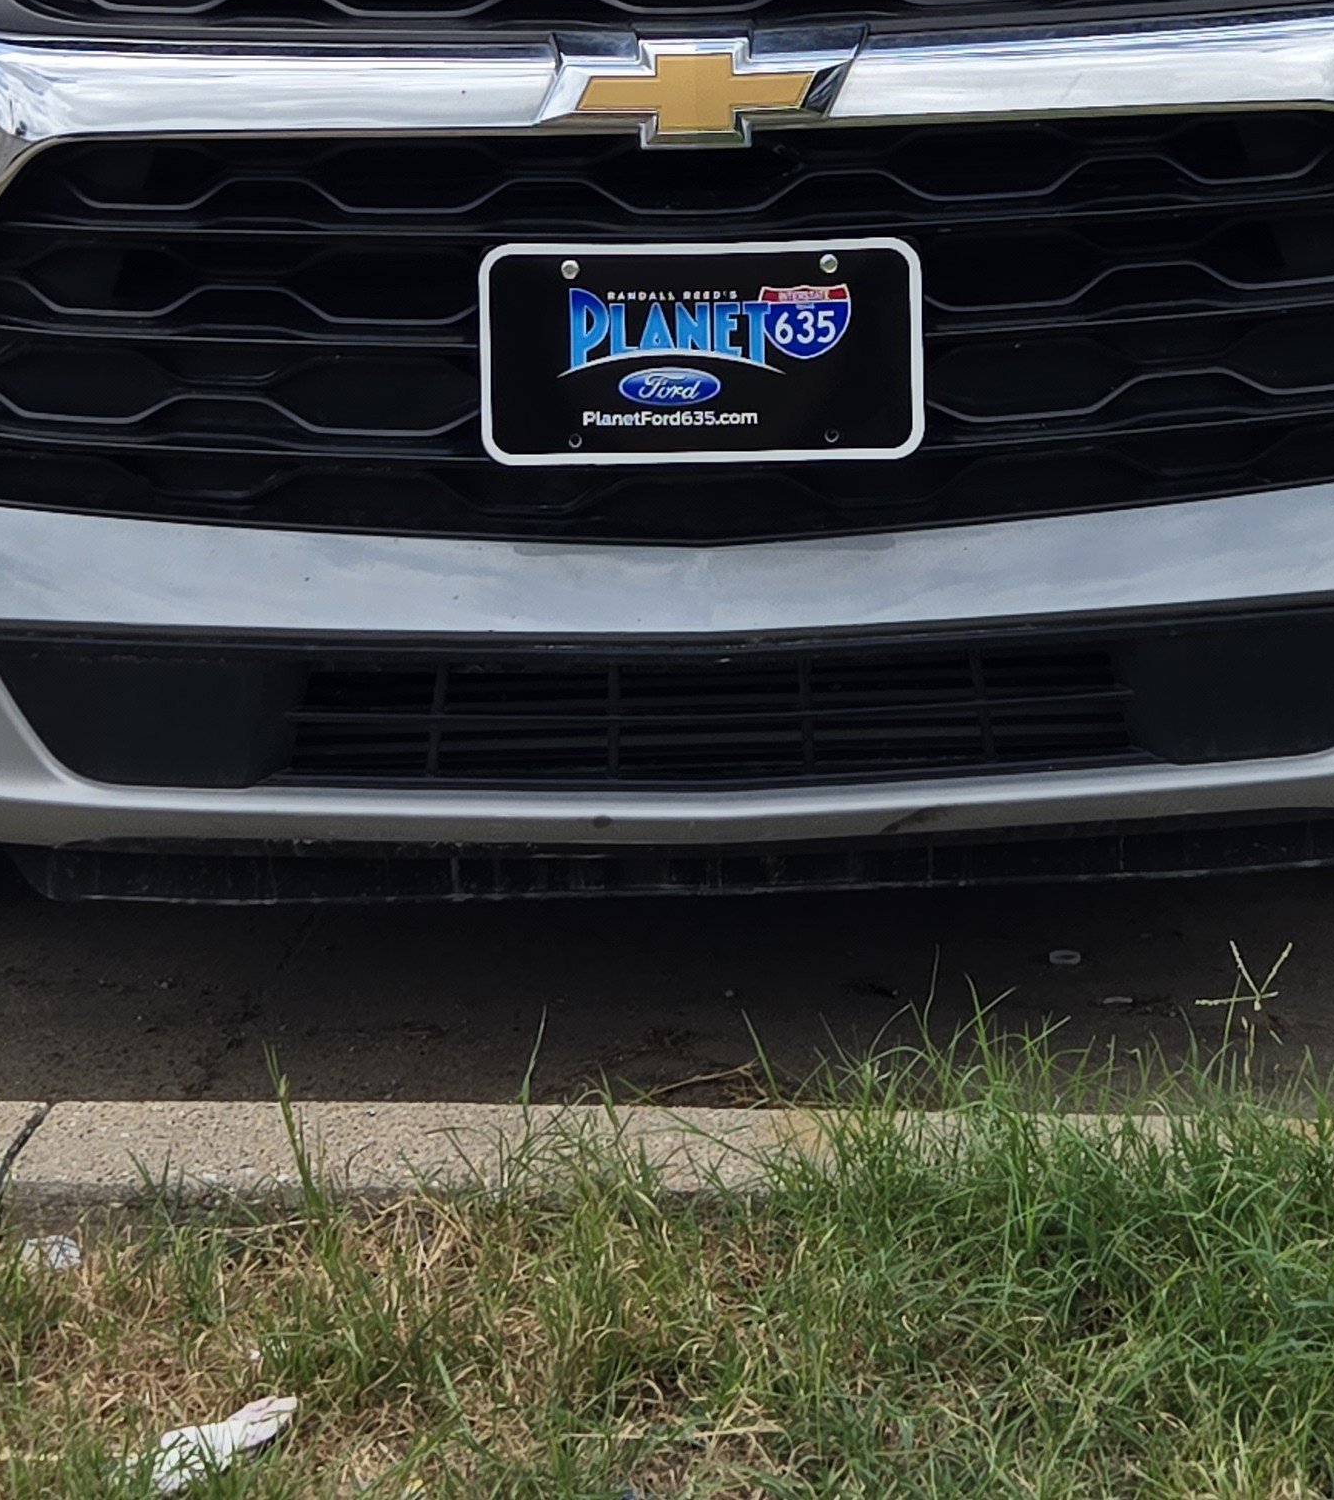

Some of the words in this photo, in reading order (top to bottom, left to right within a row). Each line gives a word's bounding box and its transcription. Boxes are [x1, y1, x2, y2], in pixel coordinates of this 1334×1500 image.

[606, 291, 676, 301] RANDALL
[569, 287, 772, 368] PLANET
[774, 310, 837, 345] 635
[638, 375, 701, 400] Ford
[582, 410, 759, 427] PlanetFord635.com
